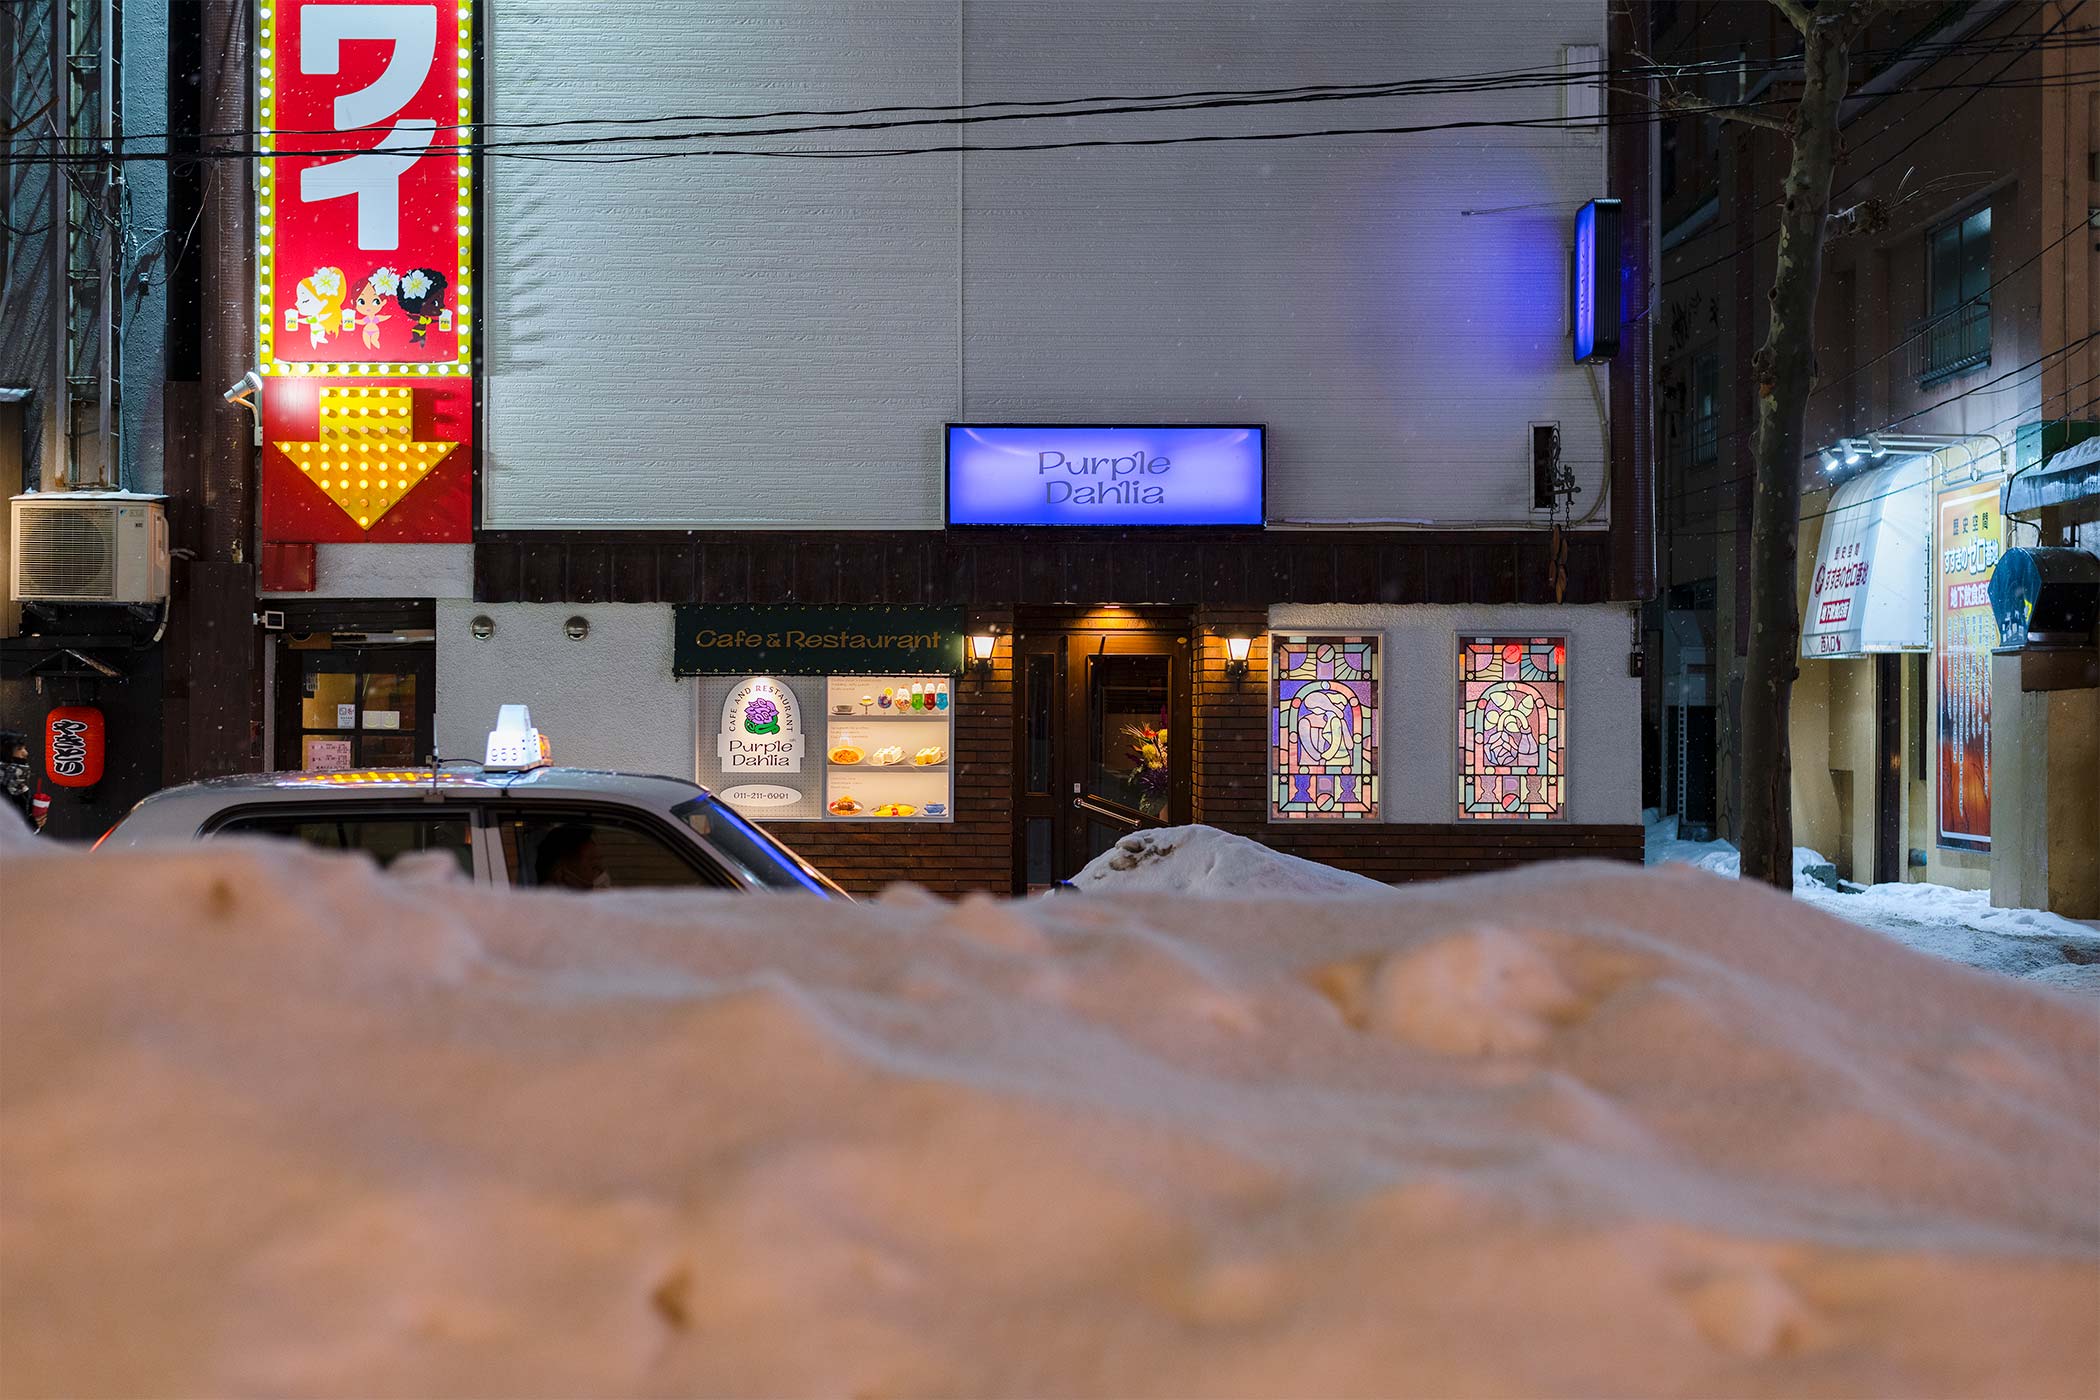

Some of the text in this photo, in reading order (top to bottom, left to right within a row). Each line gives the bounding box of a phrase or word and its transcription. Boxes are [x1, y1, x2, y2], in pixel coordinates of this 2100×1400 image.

[300, 5, 437, 251] ワイ
[1039, 450, 1171, 481] Purple
[1046, 481, 1164, 505] Dahlia
[1944, 538, 1999, 576] すすきのゼロ番地
[695, 630, 941, 649] Cafe & Restaurant
[729, 684, 794, 732] CAFE AND RESTAURANT
[729, 739, 793, 755] Purple
[732, 754, 790, 766] Dahlia
